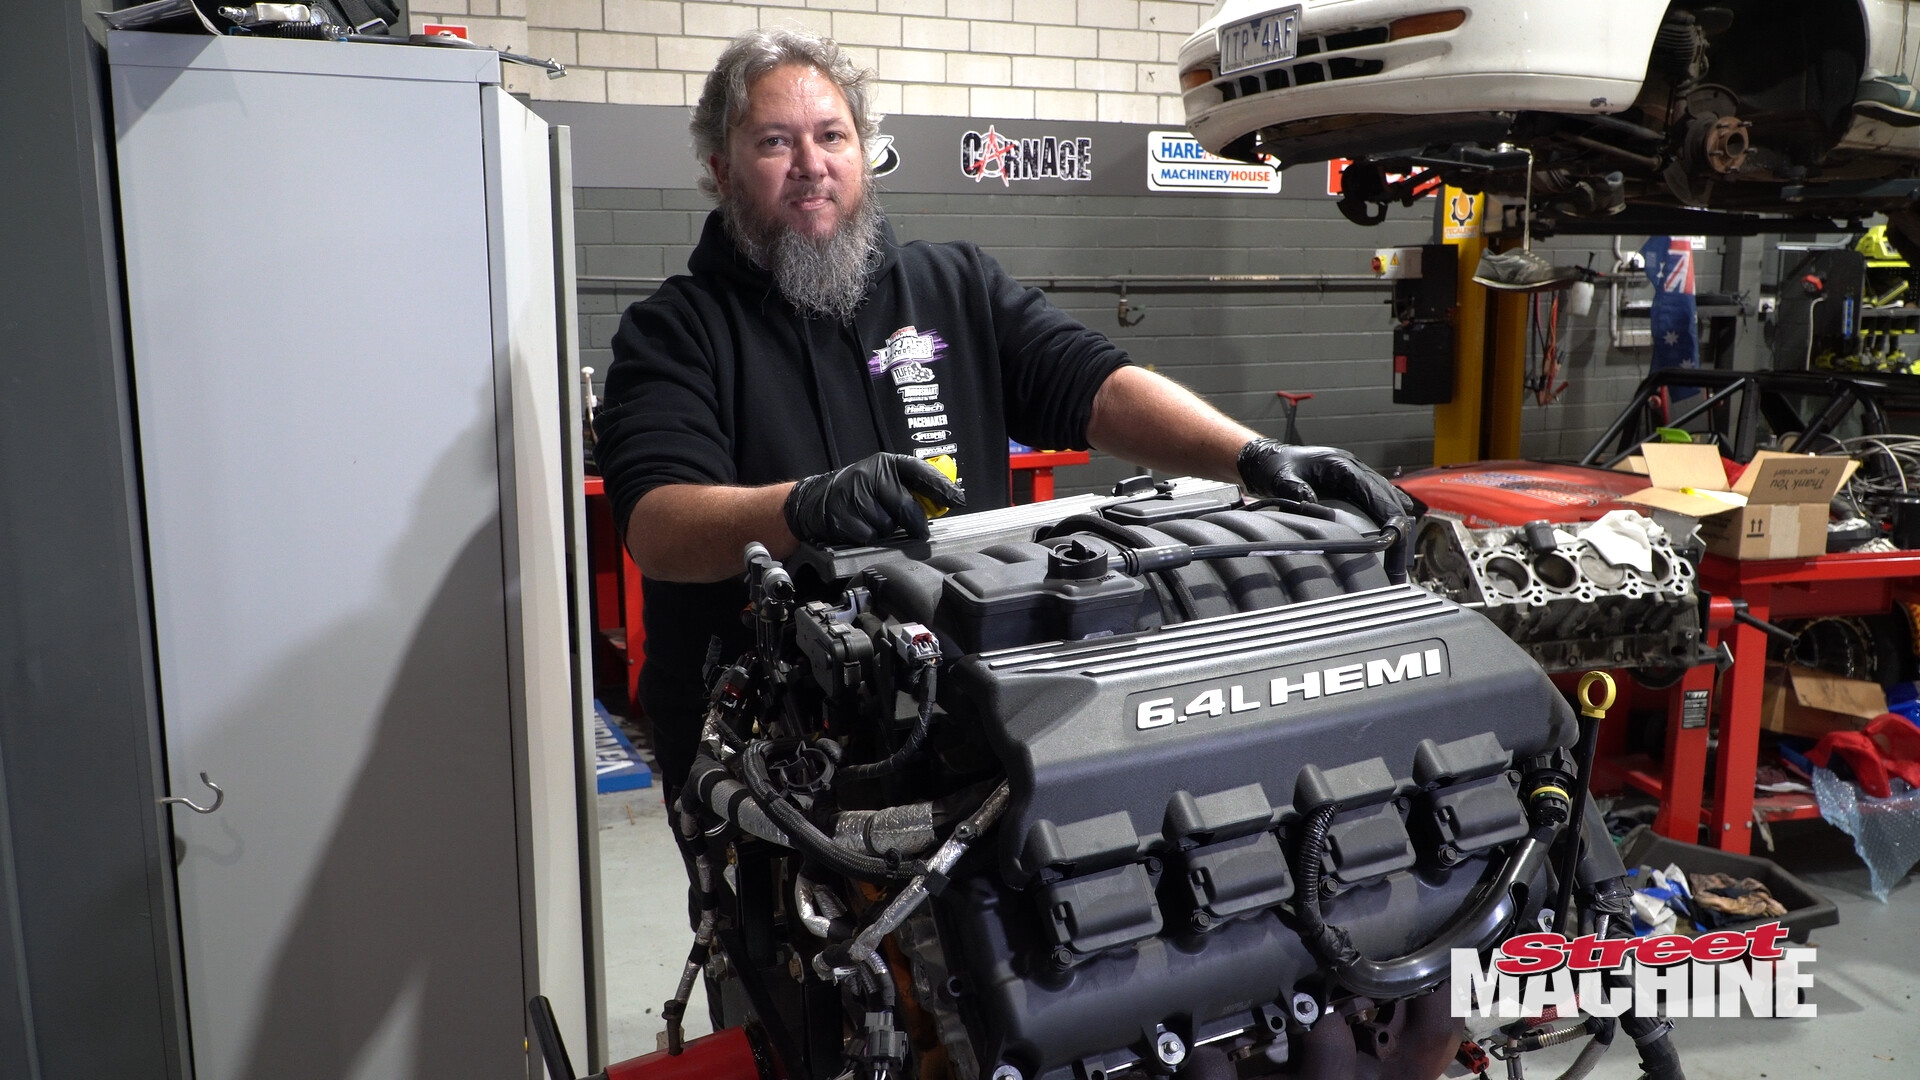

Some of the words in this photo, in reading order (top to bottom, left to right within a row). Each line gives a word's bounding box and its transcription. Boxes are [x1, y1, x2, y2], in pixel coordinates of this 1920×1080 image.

[1262, 16, 1294, 53] 4AF
[961, 125, 1091, 187] CARNAGE
[908, 414, 948, 429] PACEMAKER
[1769, 479, 1789, 490] You
[1791, 479, 1824, 491] Thank
[1136, 685, 1261, 730] 6.4L
[1270, 649, 1441, 705] HEMI
